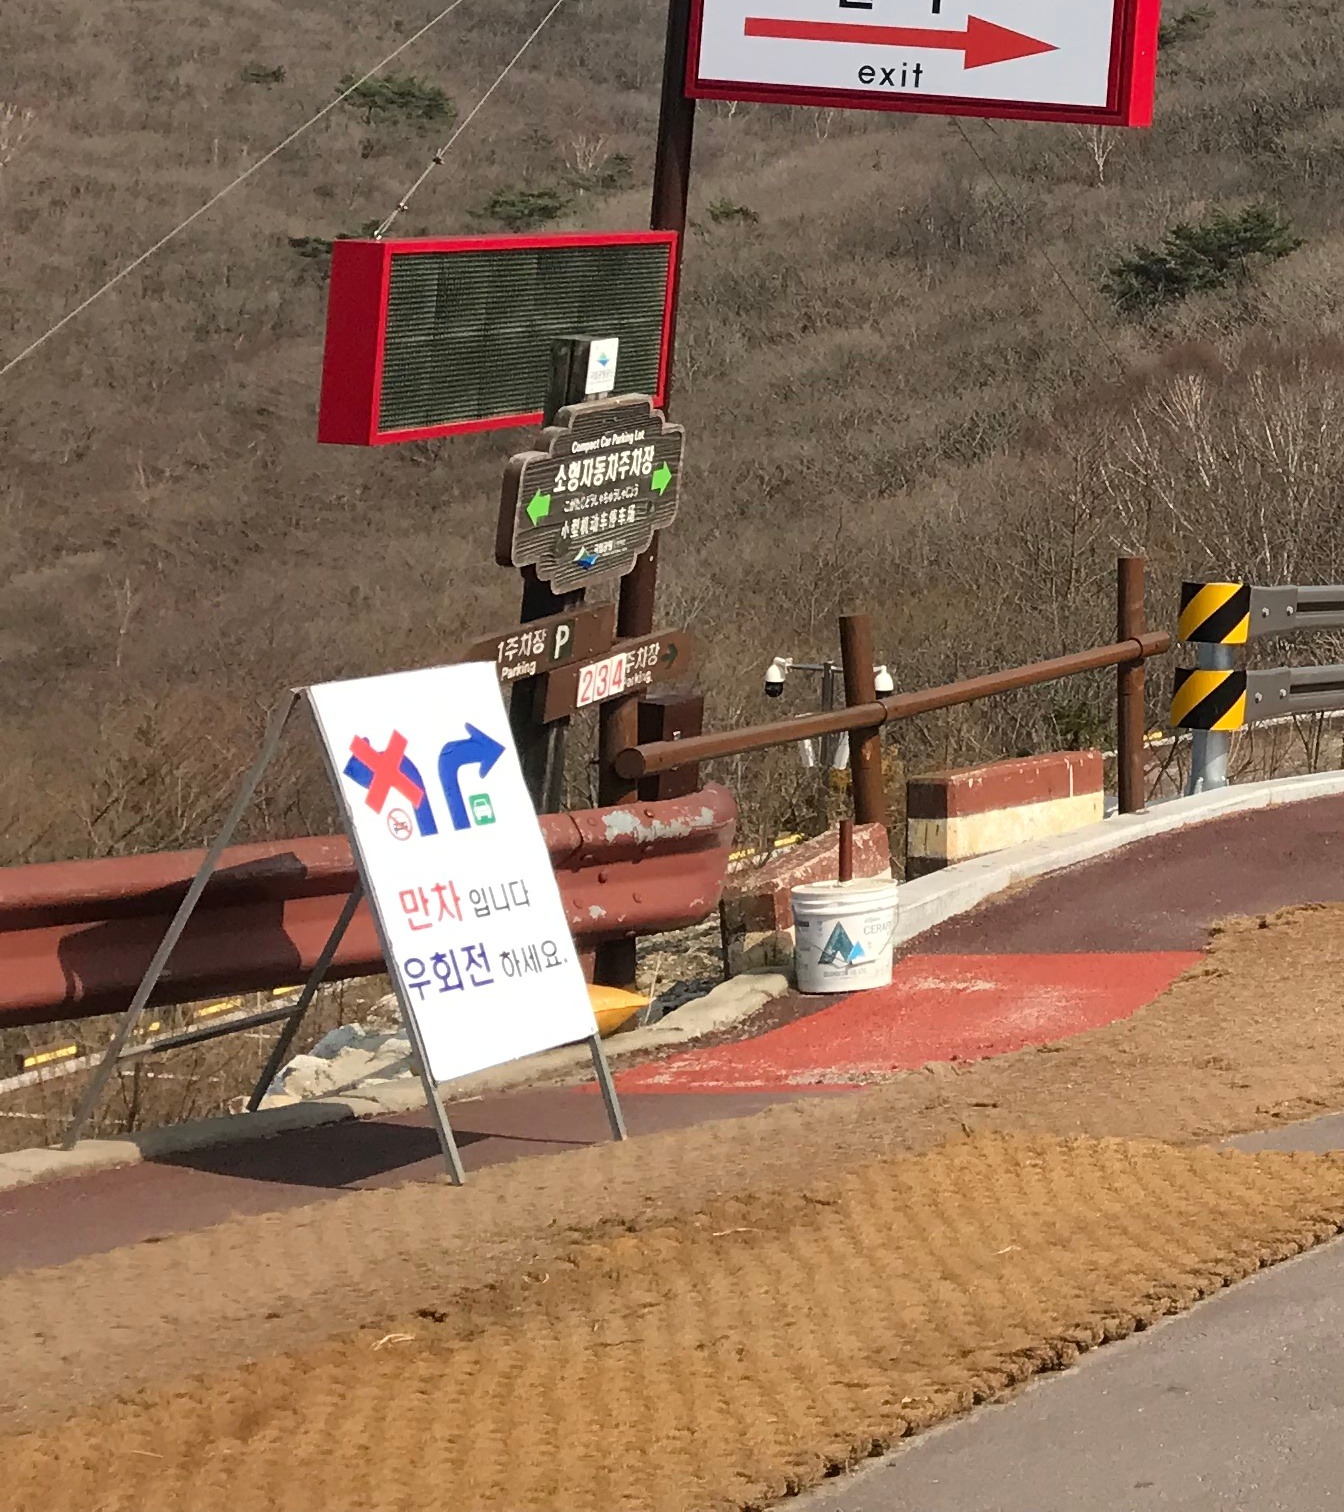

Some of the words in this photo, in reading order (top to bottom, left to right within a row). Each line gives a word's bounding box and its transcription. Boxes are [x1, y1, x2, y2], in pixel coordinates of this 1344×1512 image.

[858, 62, 923, 88] exit
[571, 439, 600, 454] Compact
[600, 435, 612, 448] Car
[611, 431, 634, 445] Parking
[634, 429, 645, 441] Lot
[553, 445, 655, 493] 소형자동차주차장
[553, 624, 571, 660] P
[500, 660, 537, 682] Parking
[623, 669, 653, 689] arking
[398, 880, 464, 931] 만차
[468, 878, 531, 918] 입니다
[403, 941, 495, 1001] 우회전
[499, 939, 569, 978] 하세요.
